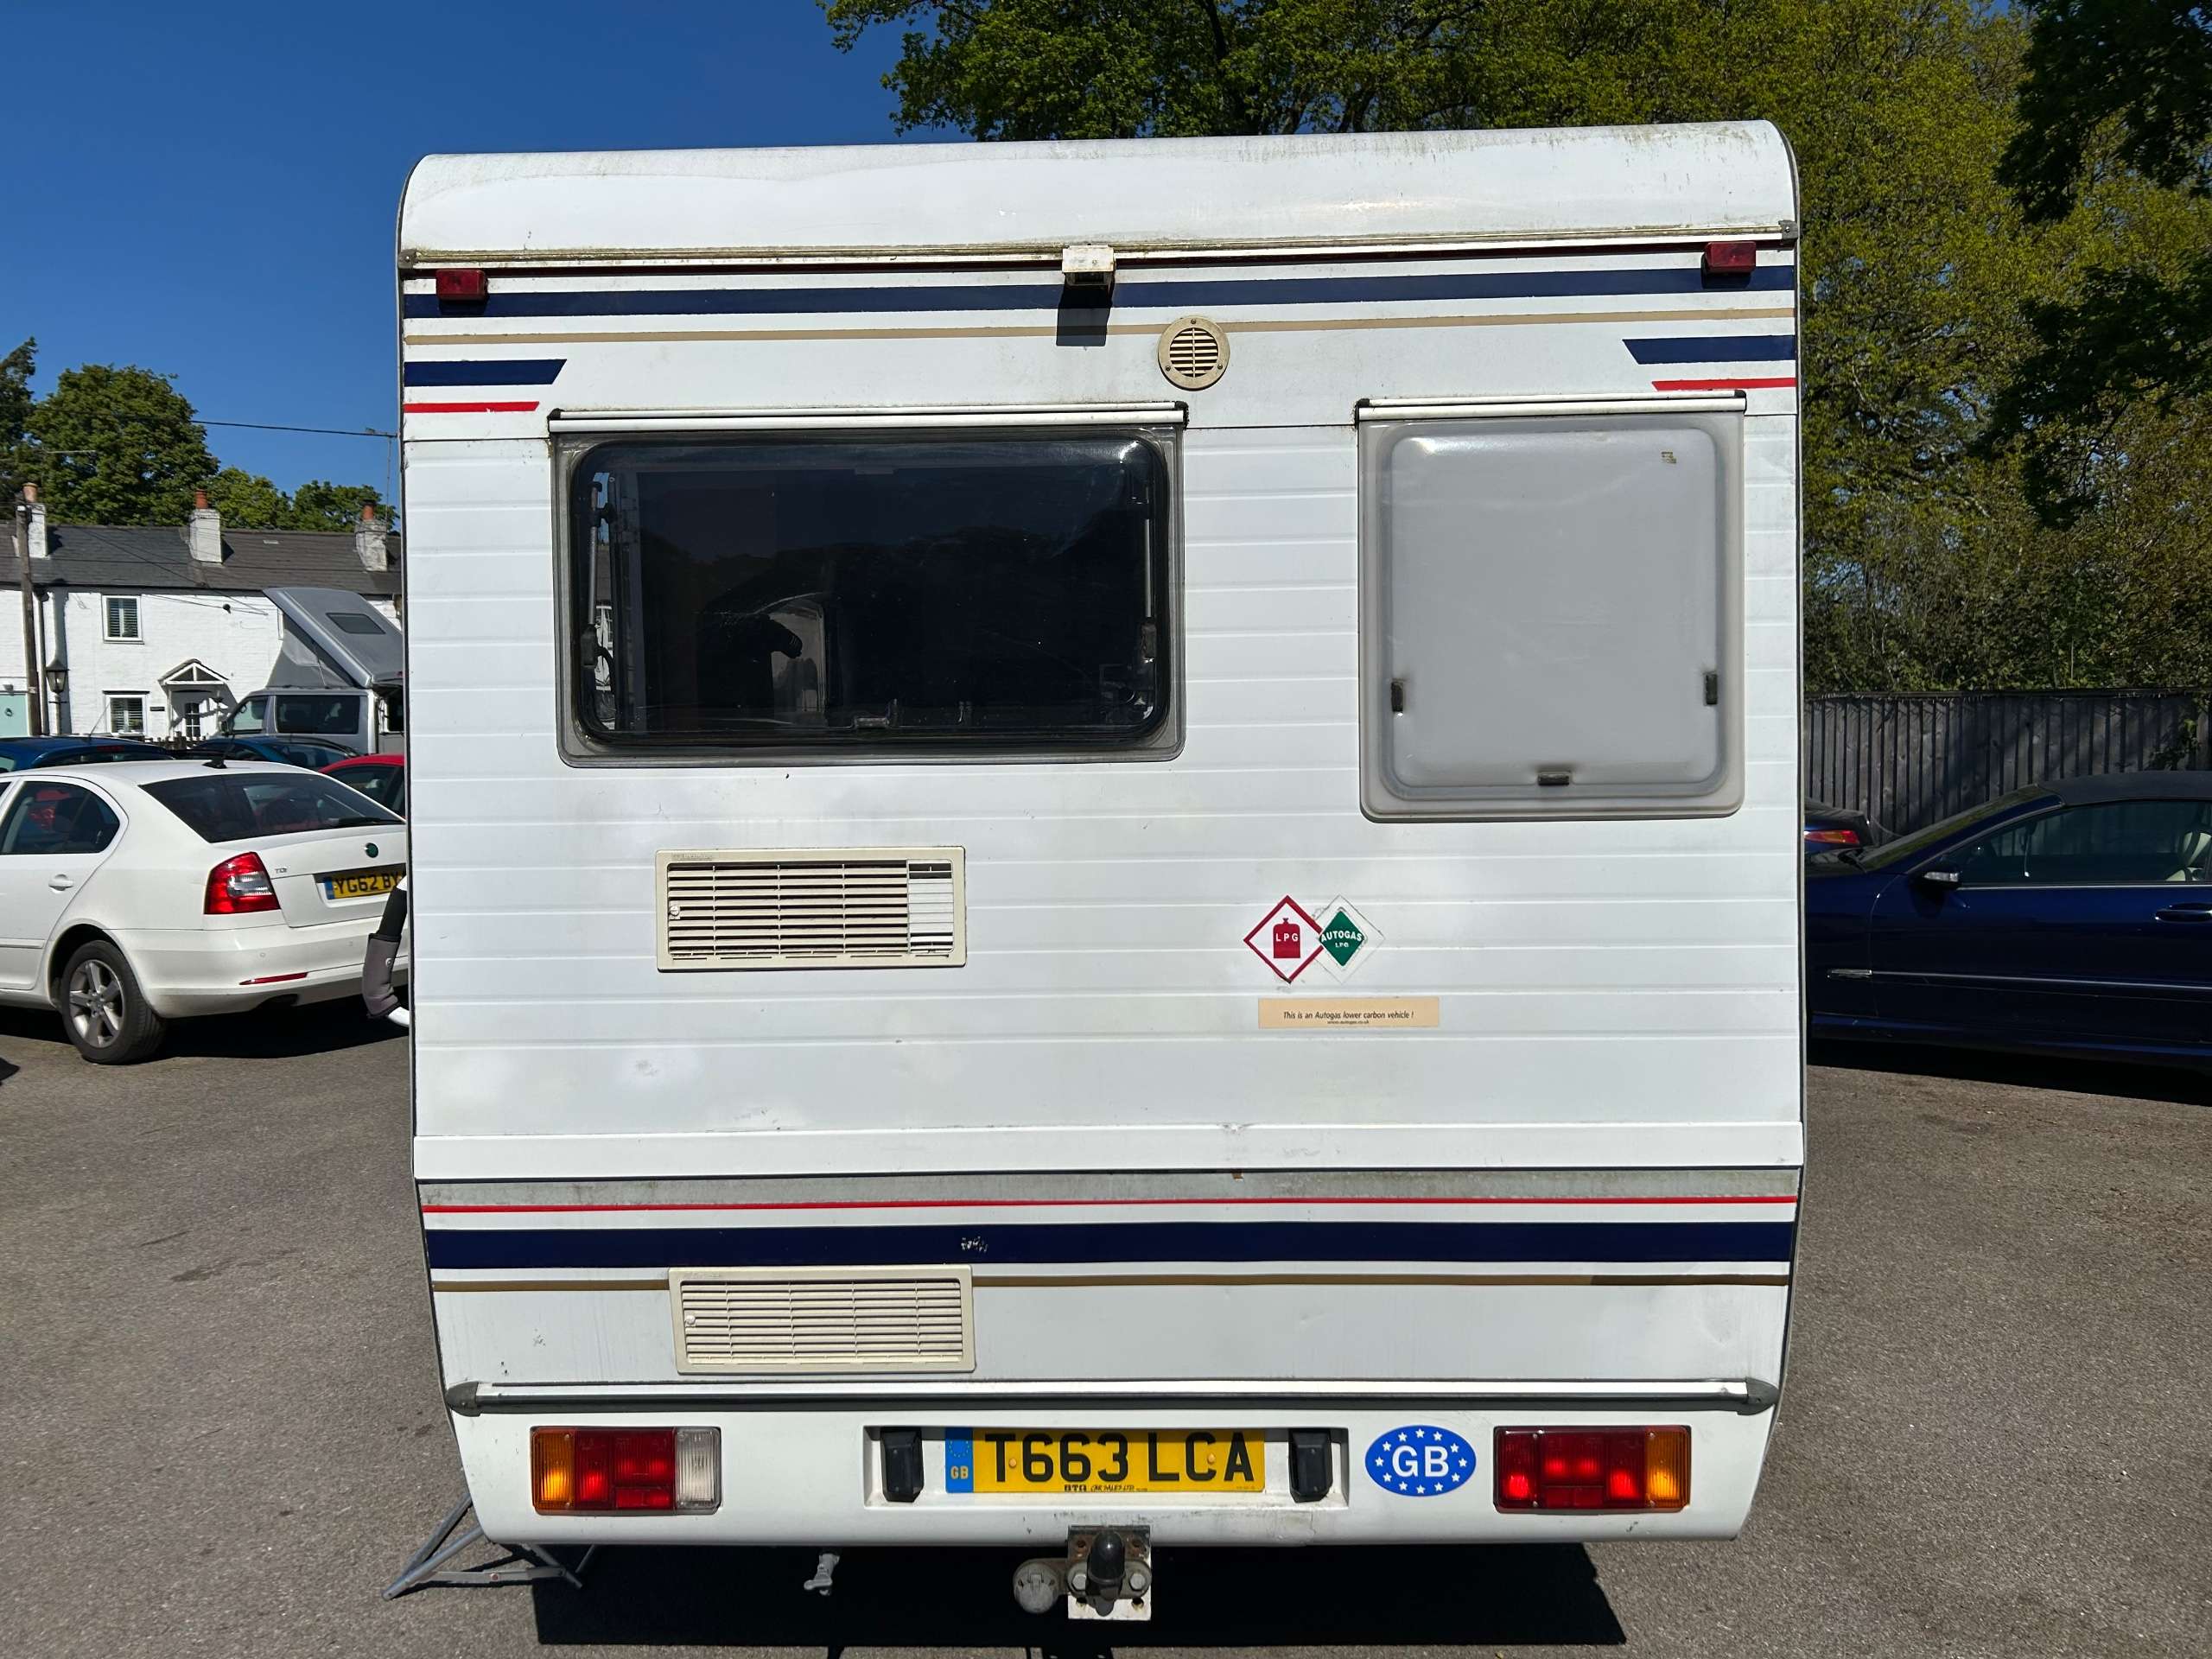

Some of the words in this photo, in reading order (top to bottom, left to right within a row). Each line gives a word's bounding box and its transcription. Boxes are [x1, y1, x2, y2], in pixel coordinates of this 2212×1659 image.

[335, 874, 378, 893] YG62
[383, 870, 402, 888] BY
[1320, 931, 1362, 943] AUTOGAS
[1315, 1011, 1341, 1020] Autogas
[1343, 1010, 1361, 1019] lower
[1388, 1010, 1409, 1019] vehicle
[985, 1433, 1128, 1483] T663
[1147, 1432, 1255, 1482] LCA
[1392, 1445, 1449, 1478] GB
[951, 1465, 969, 1479] GB
